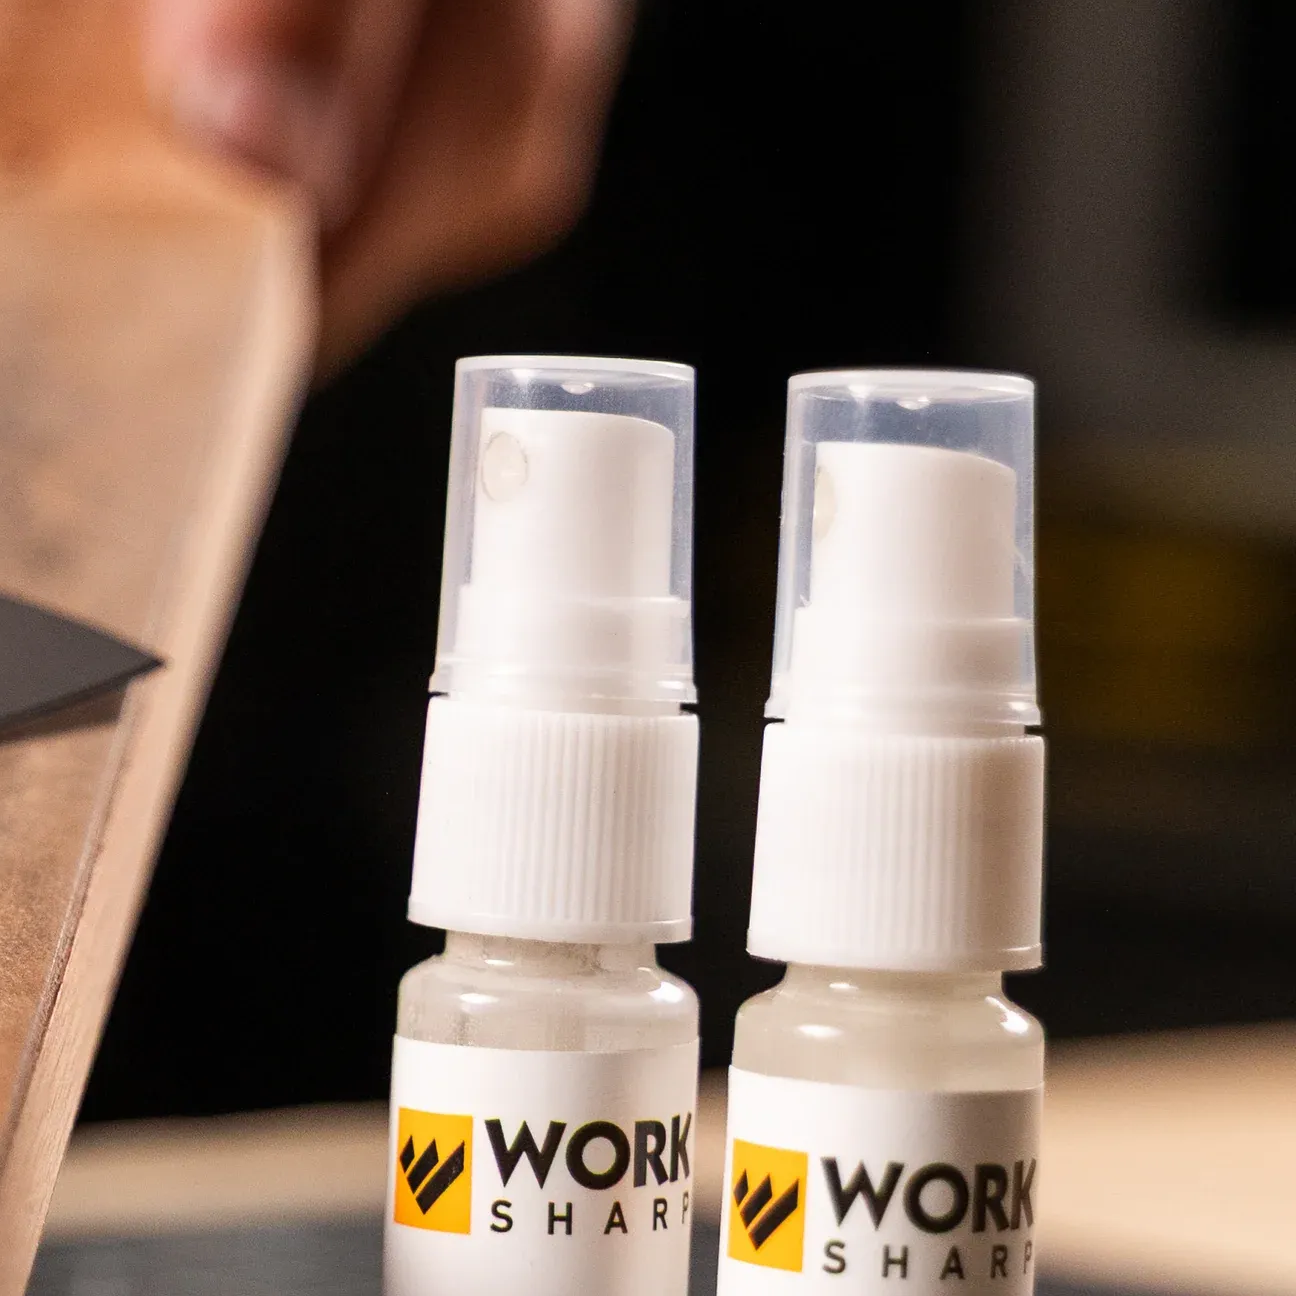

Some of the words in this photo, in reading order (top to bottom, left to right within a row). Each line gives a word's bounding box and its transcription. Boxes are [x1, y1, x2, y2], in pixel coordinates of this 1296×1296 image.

[485, 1112, 692, 1190] WORK
[490, 1191, 690, 1235] SHARP
[821, 1157, 1037, 1234] WORK
[823, 1240, 1032, 1281] SHARP
